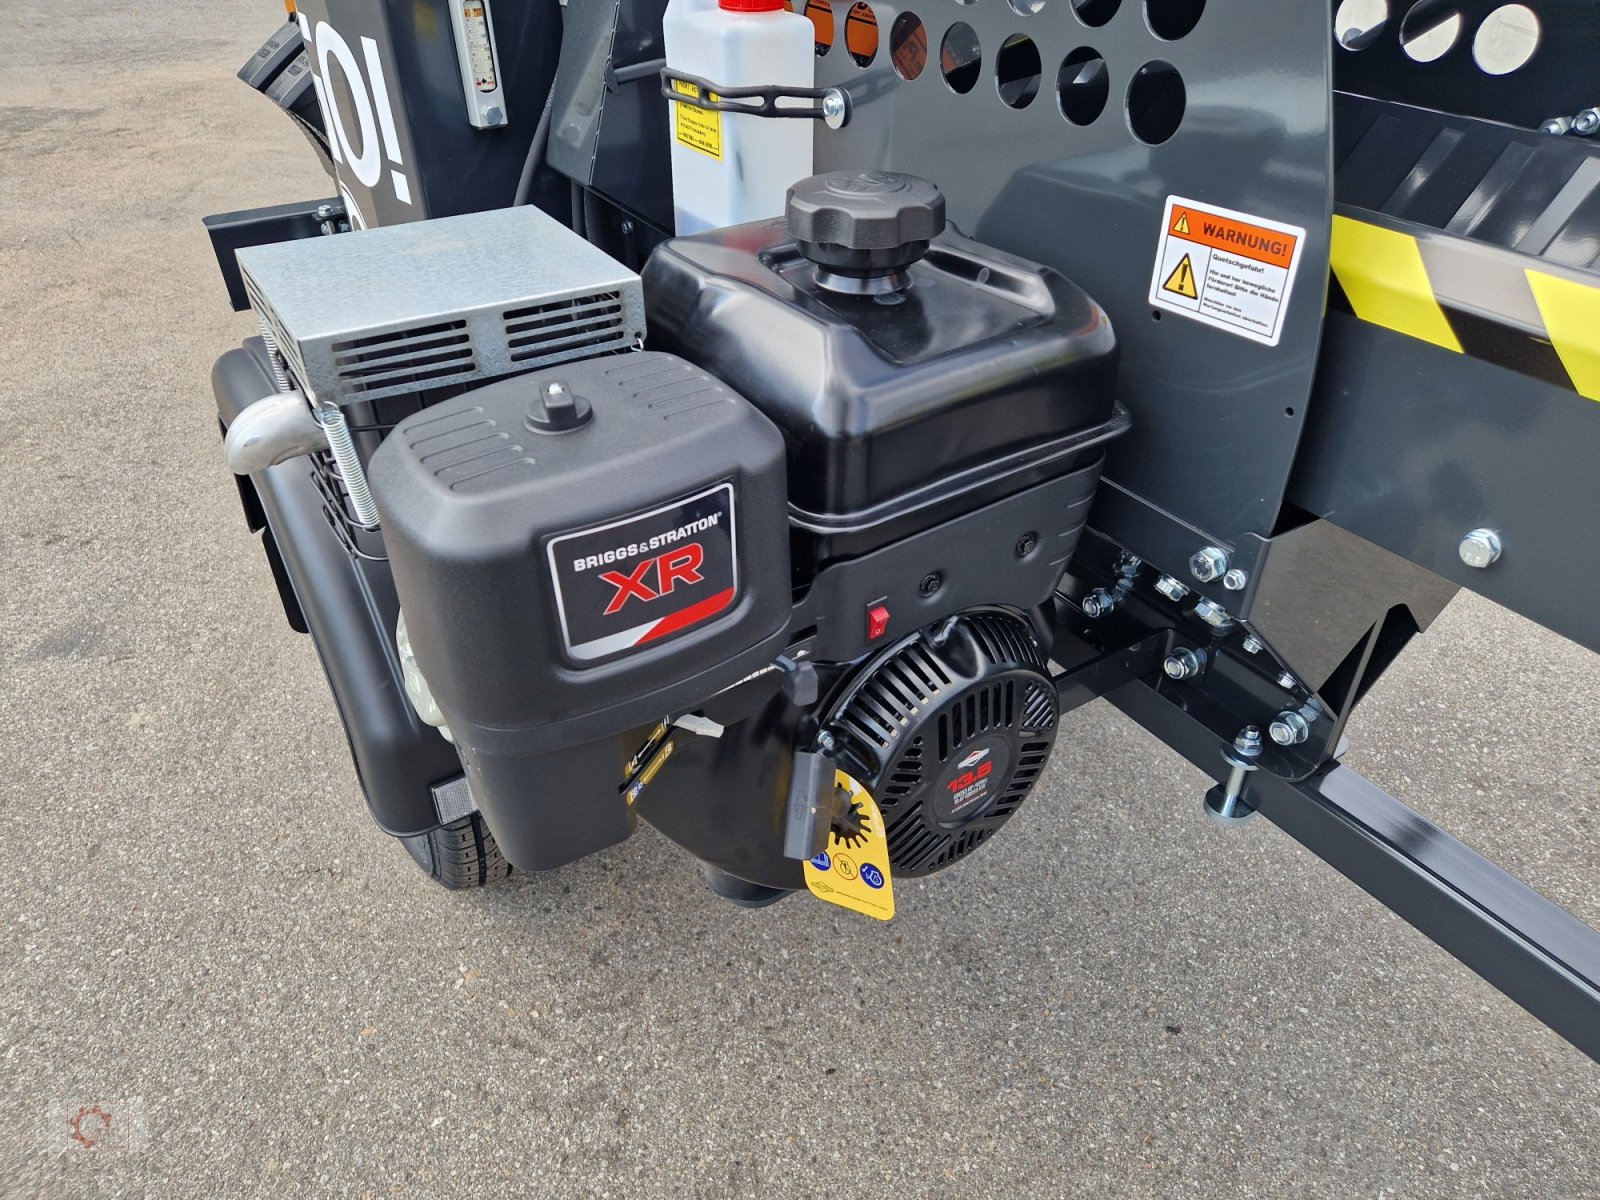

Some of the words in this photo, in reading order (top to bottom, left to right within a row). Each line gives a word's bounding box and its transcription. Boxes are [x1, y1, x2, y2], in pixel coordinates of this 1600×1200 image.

[1203, 222, 1288, 257] WARNUNG!
[1212, 253, 1264, 274] Quetschgefahr!
[598, 543, 705, 615] XR
[946, 761, 992, 793] 13.5
